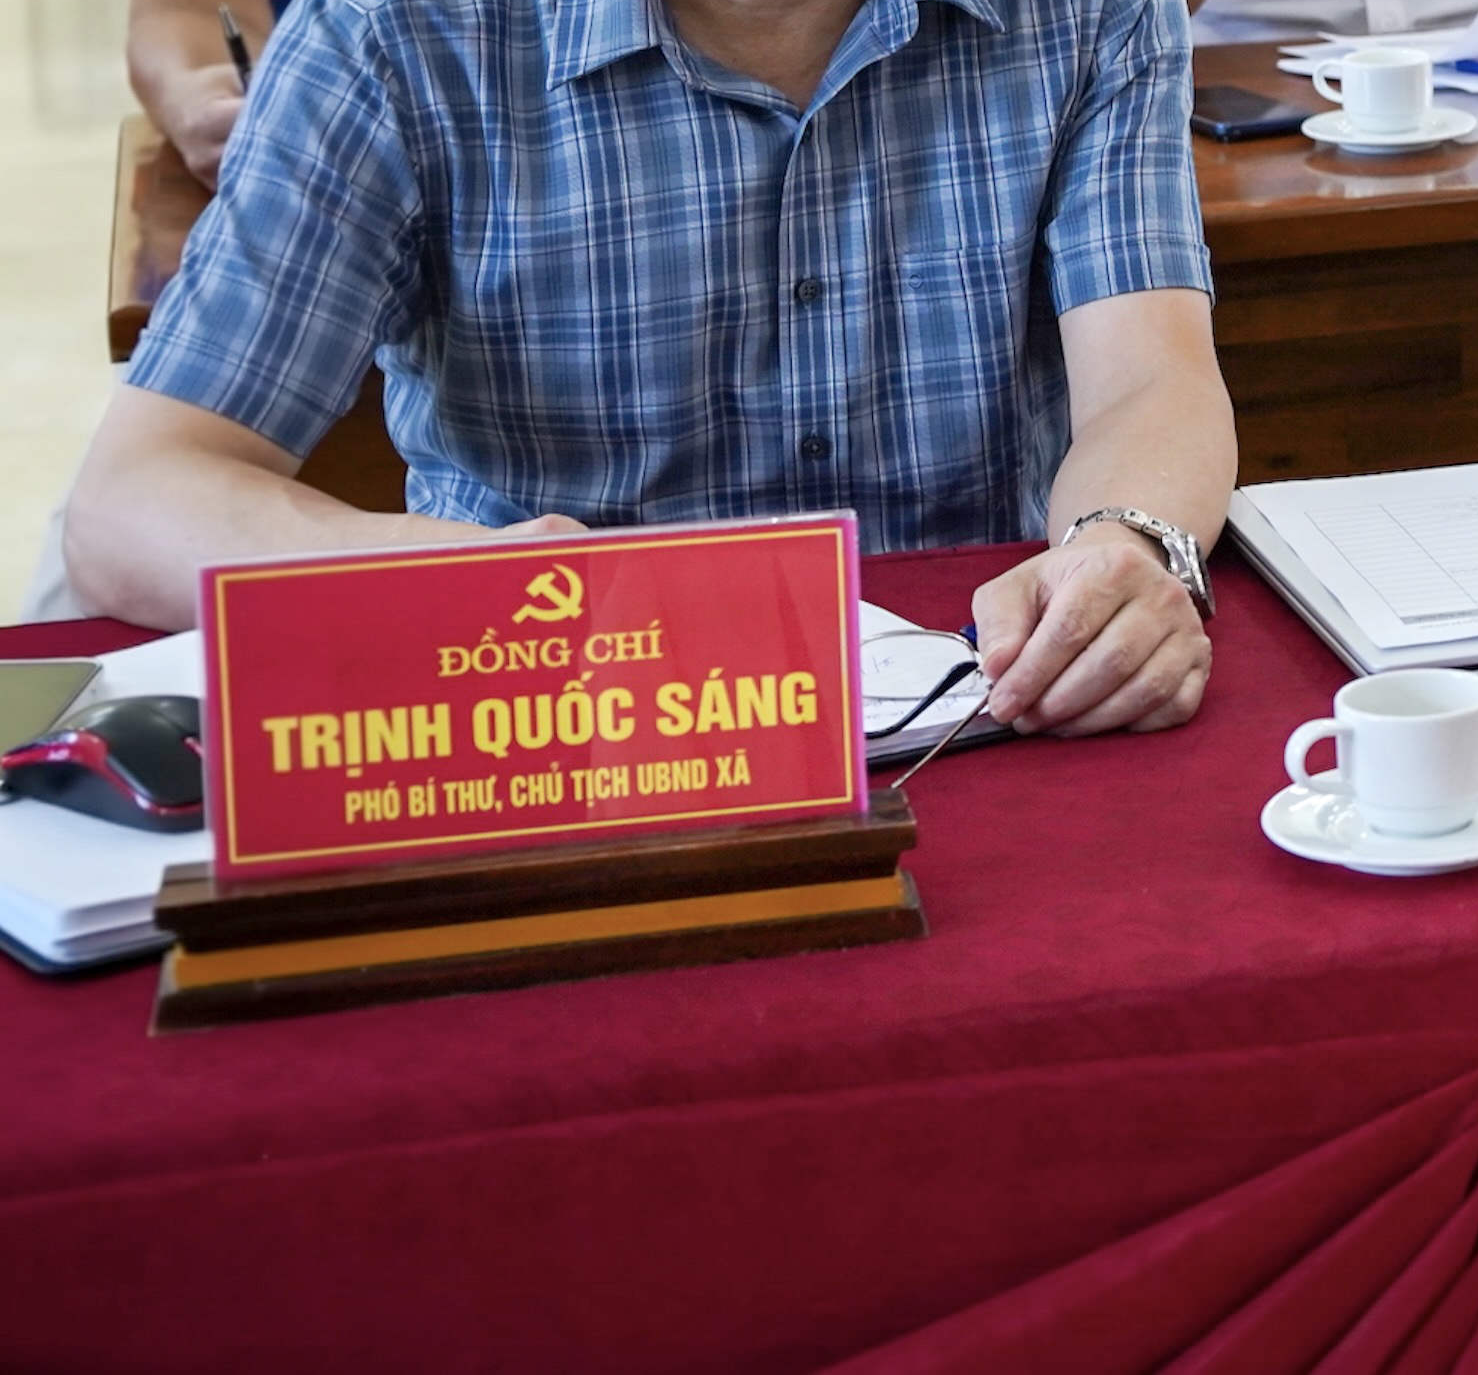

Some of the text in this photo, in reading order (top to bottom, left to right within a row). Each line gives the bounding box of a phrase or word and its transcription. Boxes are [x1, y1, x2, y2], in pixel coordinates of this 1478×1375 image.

[439, 621, 662, 676] ĐỒNG CHÍ
[264, 669, 816, 776] TRỊNH QUỐC SÁNG
[347, 751, 750, 822] PHÓ BÍ THƯ, CHỦ TỊCH UBND XÃ
